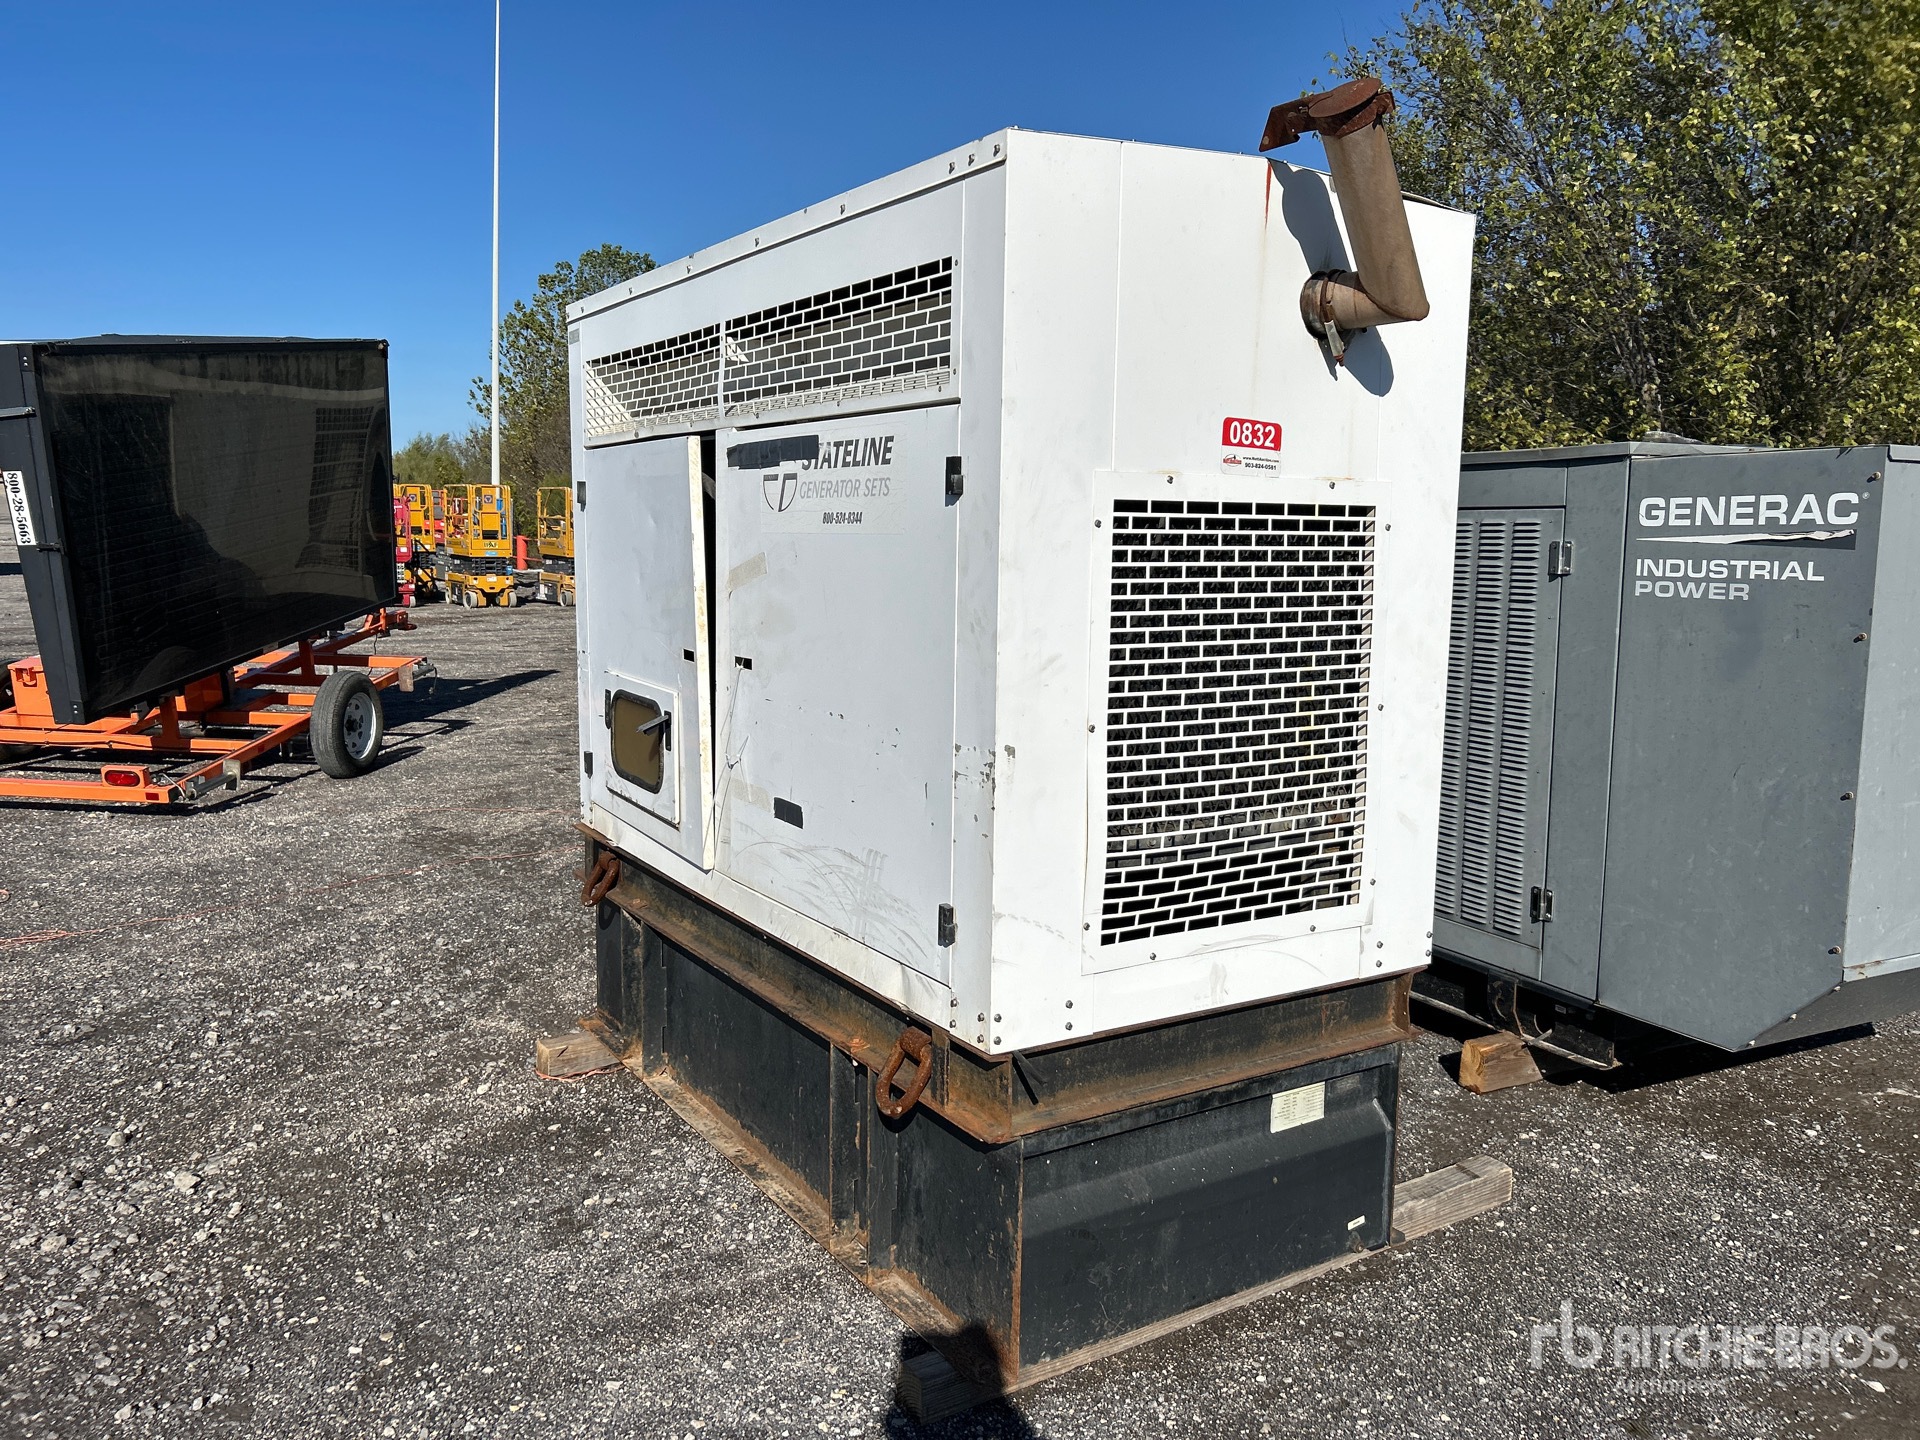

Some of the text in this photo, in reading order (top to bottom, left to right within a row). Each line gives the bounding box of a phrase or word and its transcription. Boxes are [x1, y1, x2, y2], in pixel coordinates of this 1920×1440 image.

[1229, 420, 1276, 448] 0832
[799, 476, 891, 499] GENERATOR SETS
[6, 472, 32, 544] 800-28-5663
[822, 511, 863, 525] 800-524-8344
[1635, 558, 1825, 582] INDUSTRIAL
[1634, 580, 1750, 601] POWER
